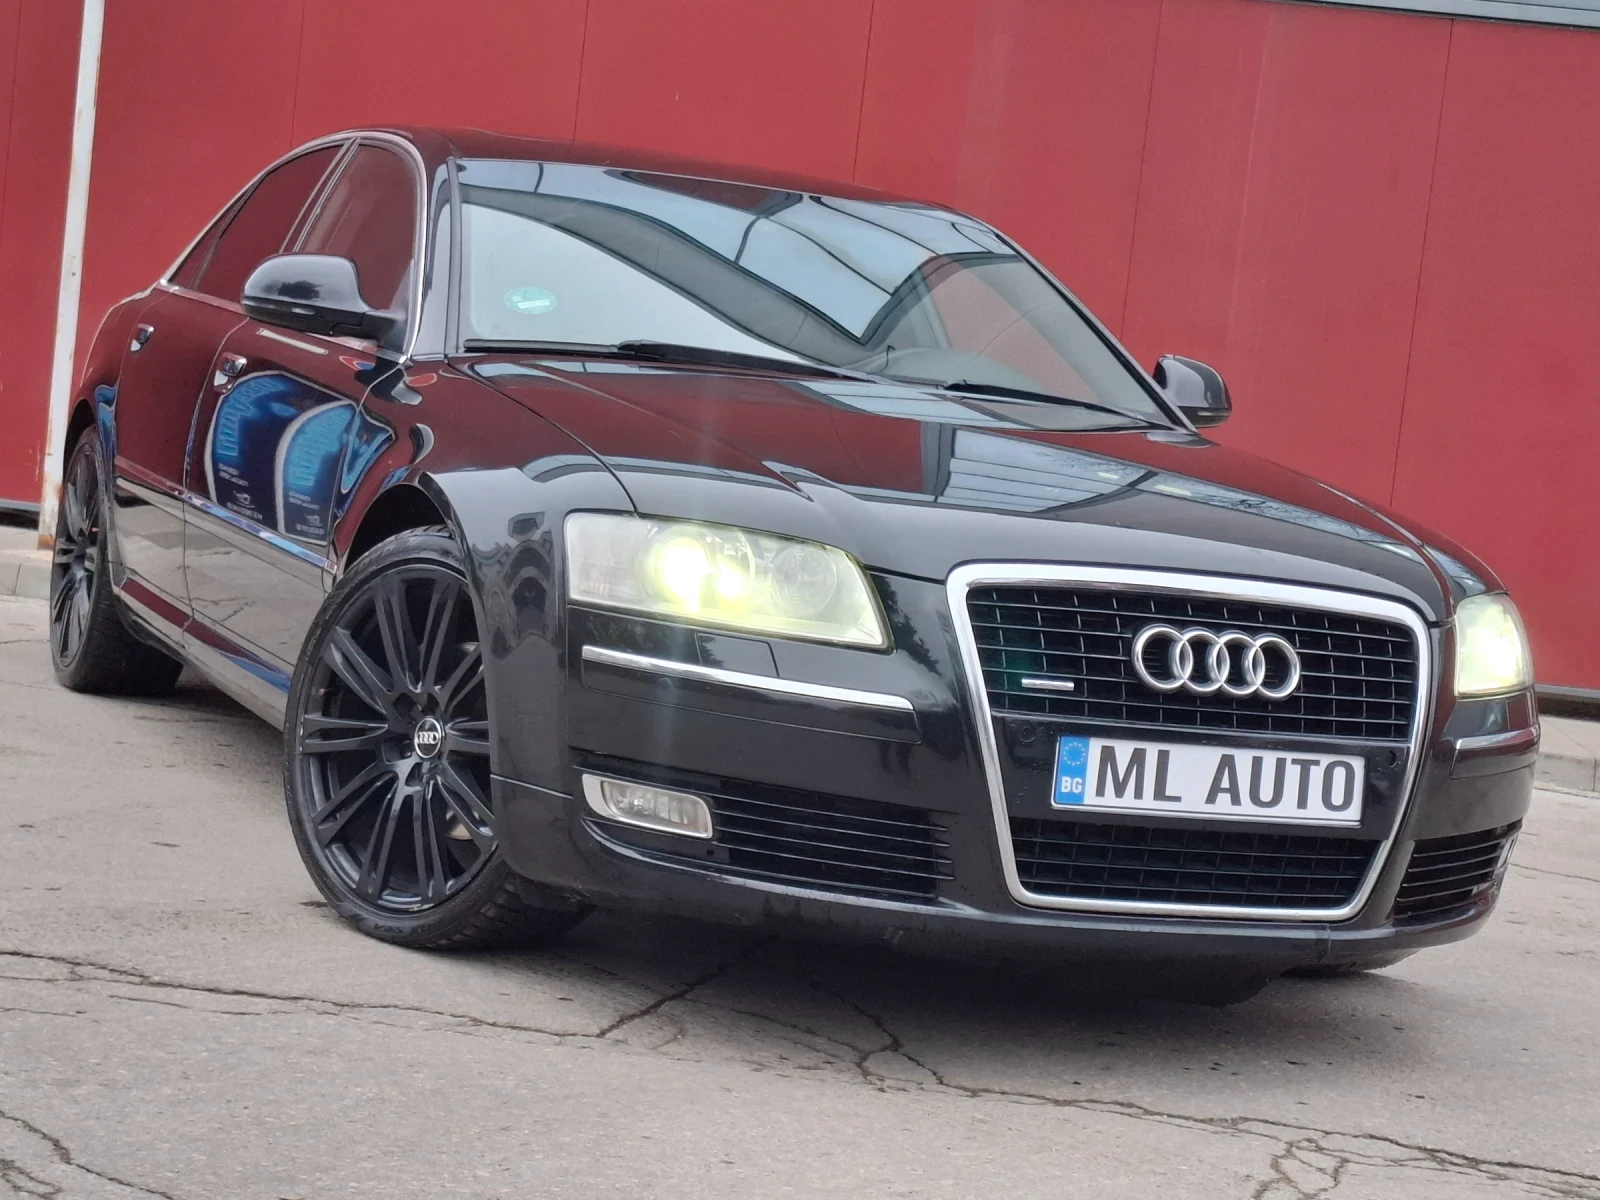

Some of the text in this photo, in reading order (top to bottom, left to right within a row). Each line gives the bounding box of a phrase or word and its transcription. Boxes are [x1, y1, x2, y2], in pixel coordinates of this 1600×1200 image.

[1061, 776, 1083, 793] BG
[1095, 745, 1356, 812] ML AUTO
